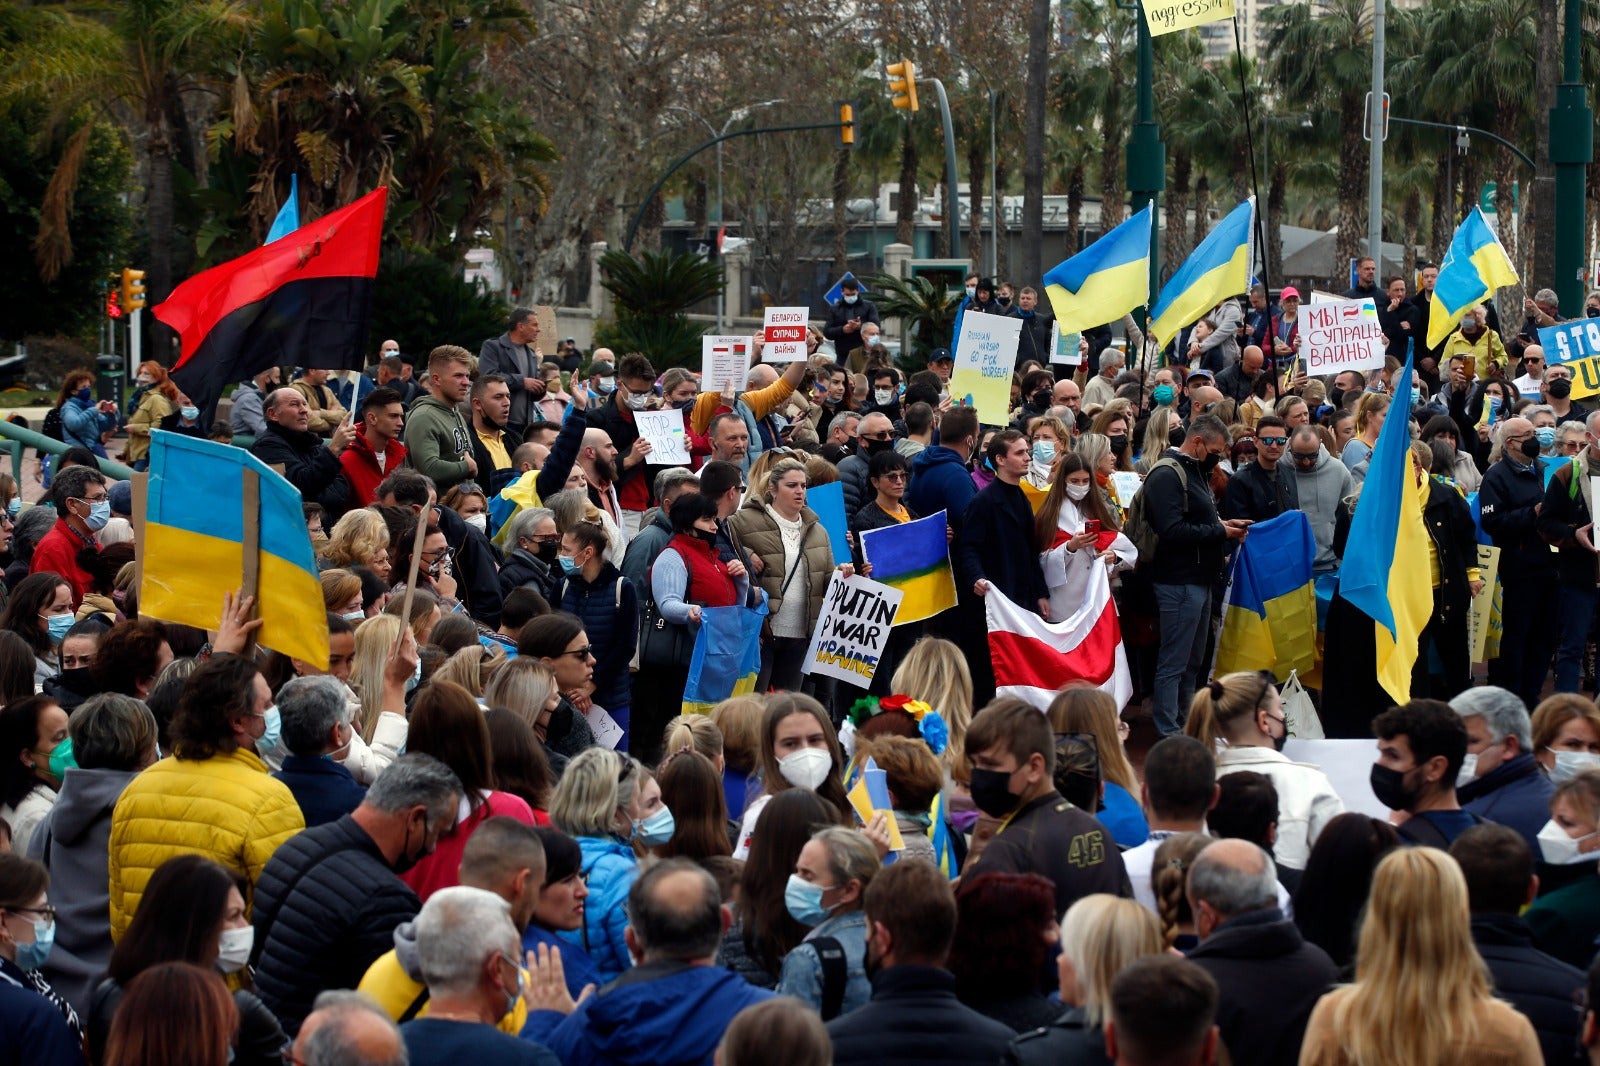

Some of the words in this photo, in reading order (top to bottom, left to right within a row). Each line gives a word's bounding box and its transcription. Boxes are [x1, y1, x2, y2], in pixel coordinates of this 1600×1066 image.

[771, 313, 803, 323] БЕЛАРУСЫ
[1309, 306, 1339, 329] МЫ
[772, 329, 800, 339] СУПРАЦЬ
[1309, 322, 1382, 346] СУПРАЦЬ
[774, 343, 797, 354] ВАЙНЫ
[970, 350, 979, 363] GO
[1310, 341, 1372, 367] ВАЙНЫ
[641, 415, 670, 437] STOP
[653, 437, 681, 462] WAR
[1482, 504, 1495, 515] HH
[832, 617, 881, 650] WAR
[1068, 830, 1105, 868] 46
